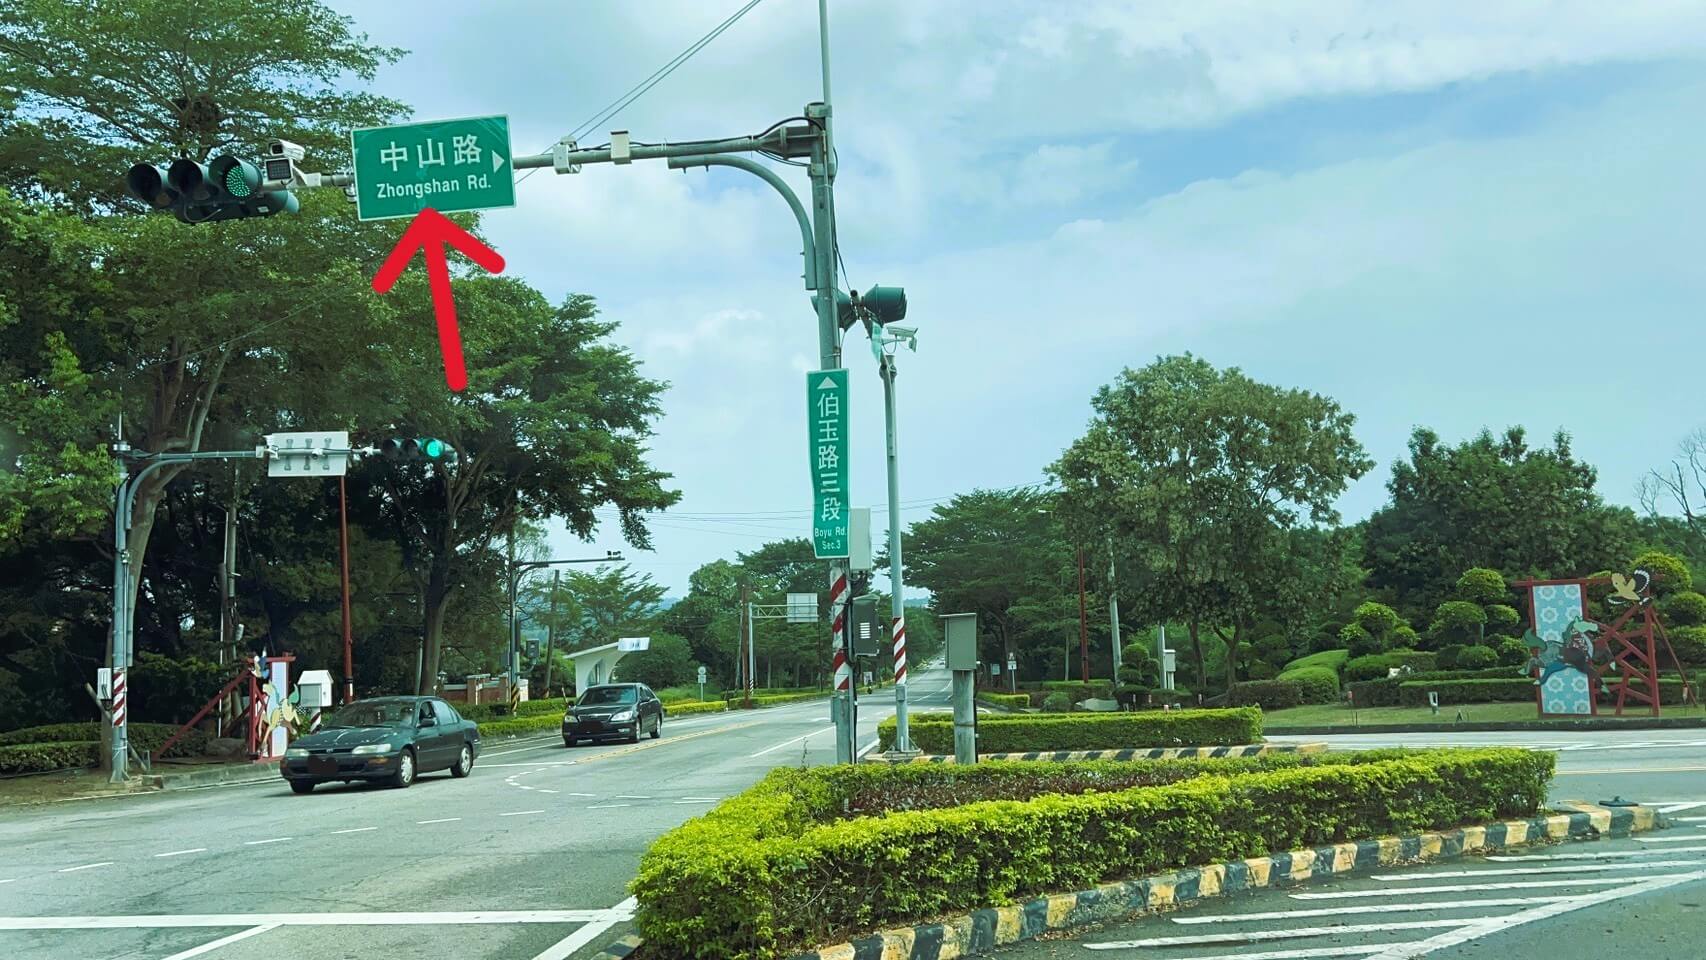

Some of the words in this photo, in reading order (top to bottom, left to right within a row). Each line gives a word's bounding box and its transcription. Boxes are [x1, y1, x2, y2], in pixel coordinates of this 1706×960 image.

[380, 134, 482, 172] 中山路
[376, 178, 460, 199] Zhongshan
[467, 174, 492, 190] Rd.
[817, 393, 840, 521] 伯玉路三段
[814, 527, 832, 539] Boyu
